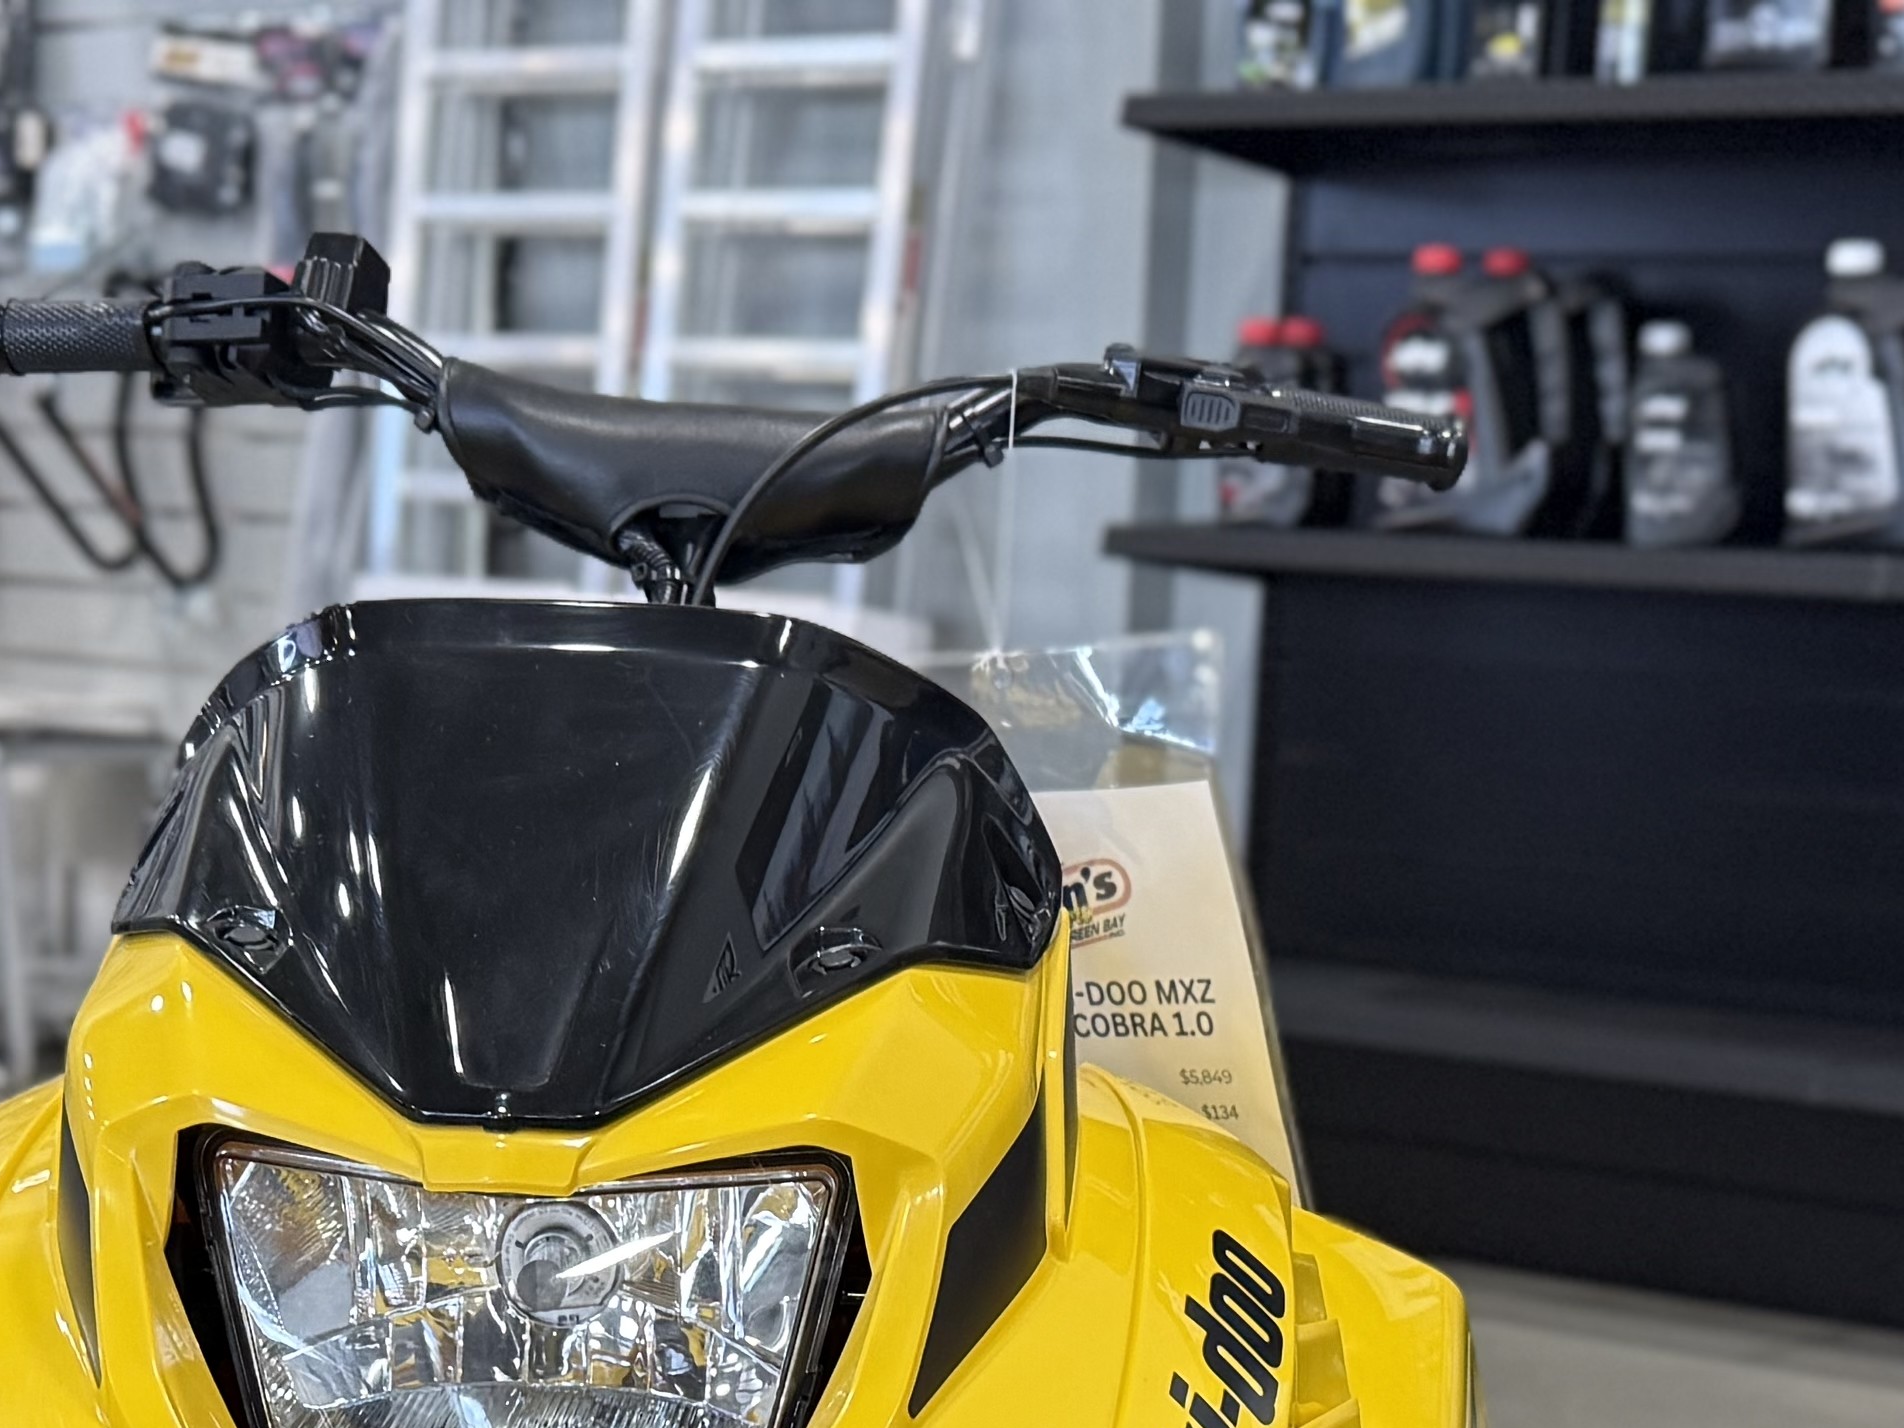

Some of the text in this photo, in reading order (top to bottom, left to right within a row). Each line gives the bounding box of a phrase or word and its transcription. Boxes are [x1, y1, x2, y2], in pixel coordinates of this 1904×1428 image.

[1103, 913, 1125, 932] BAY
[1155, 979, 1216, 1005] MXZ
[1073, 1011, 1214, 1038] COBRA 1.0
[1179, 1068, 1233, 1086] $5,849
[1201, 1104, 1239, 1121] $134
